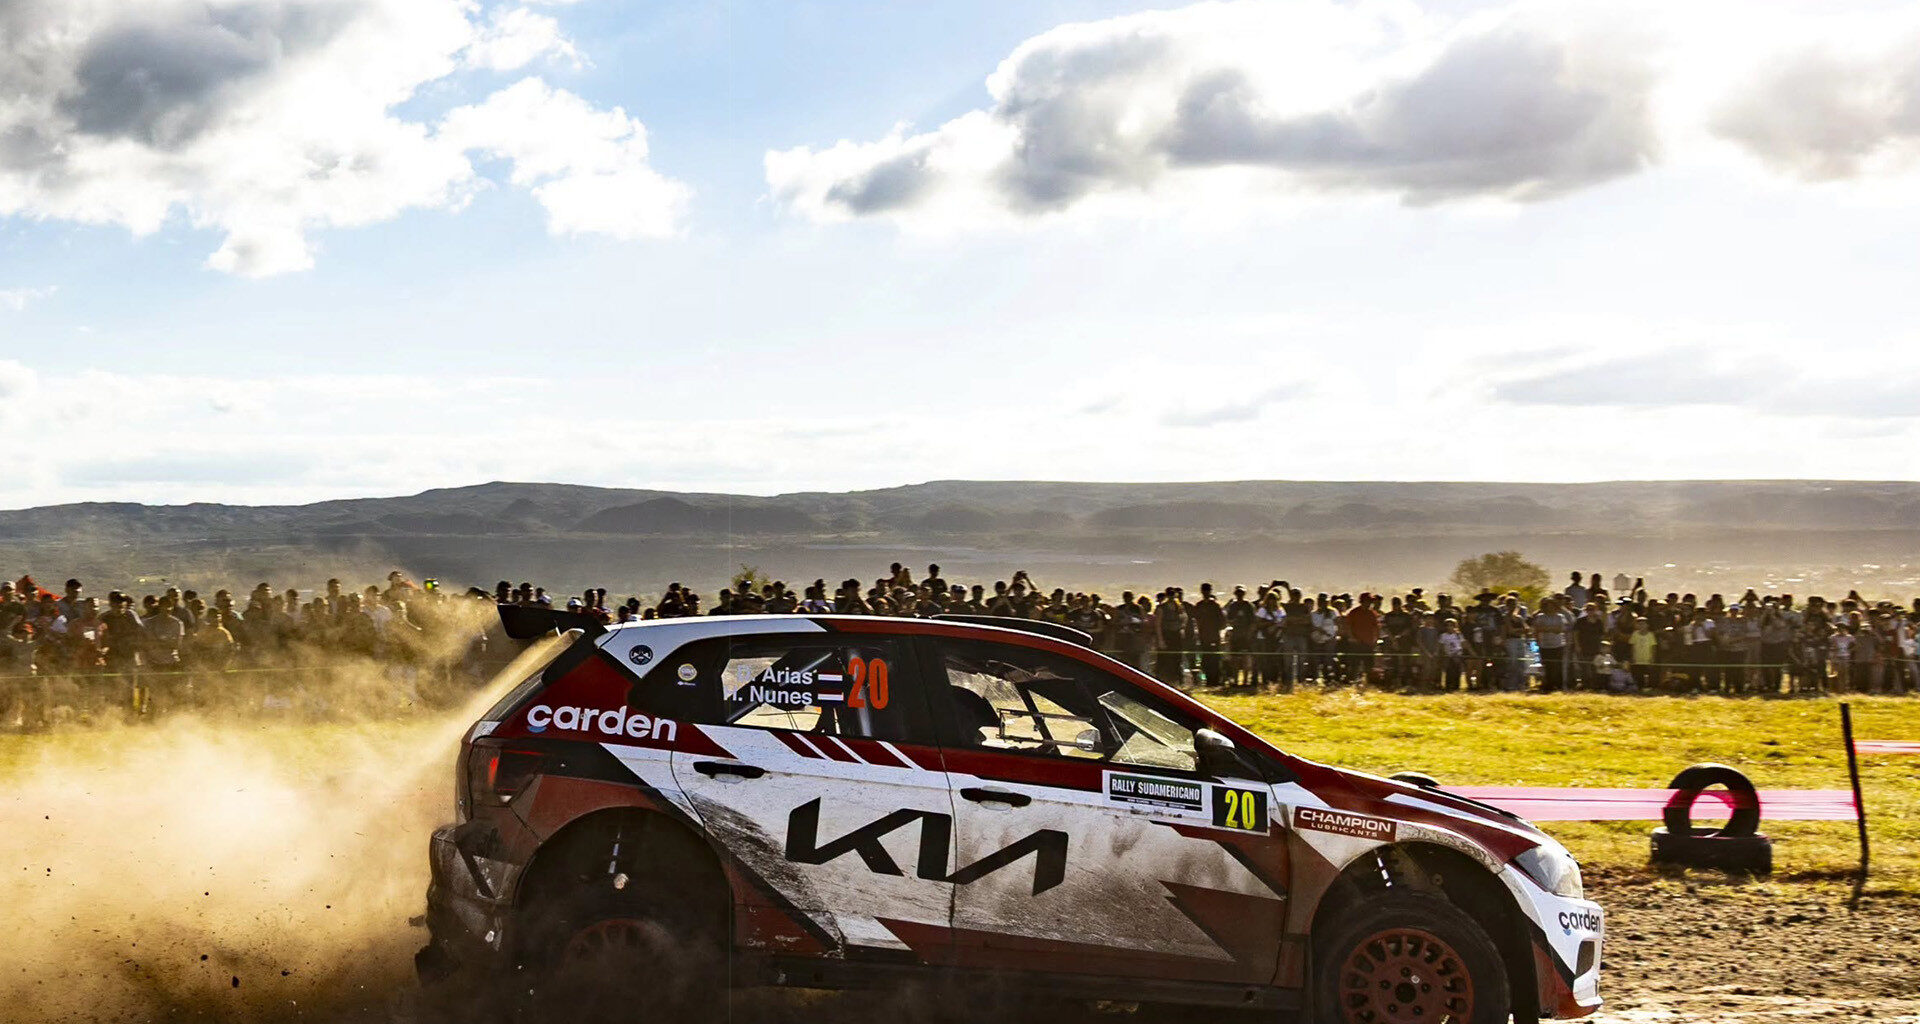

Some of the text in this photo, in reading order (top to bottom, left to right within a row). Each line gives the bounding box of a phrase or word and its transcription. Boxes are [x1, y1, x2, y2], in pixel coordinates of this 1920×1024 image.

[761, 666, 813, 685] Arias
[848, 657, 889, 709] 20
[750, 685, 813, 705] Nunes
[527, 704, 677, 741] carden
[1111, 778, 1200, 800] RALLY SUDAMERICANO
[1225, 789, 1256, 830] 20
[1300, 810, 1391, 832] CHAMPION
[1311, 823, 1378, 838] LUBRICANTS
[785, 796, 1069, 897] KIA
[1558, 909, 1600, 932] carden
